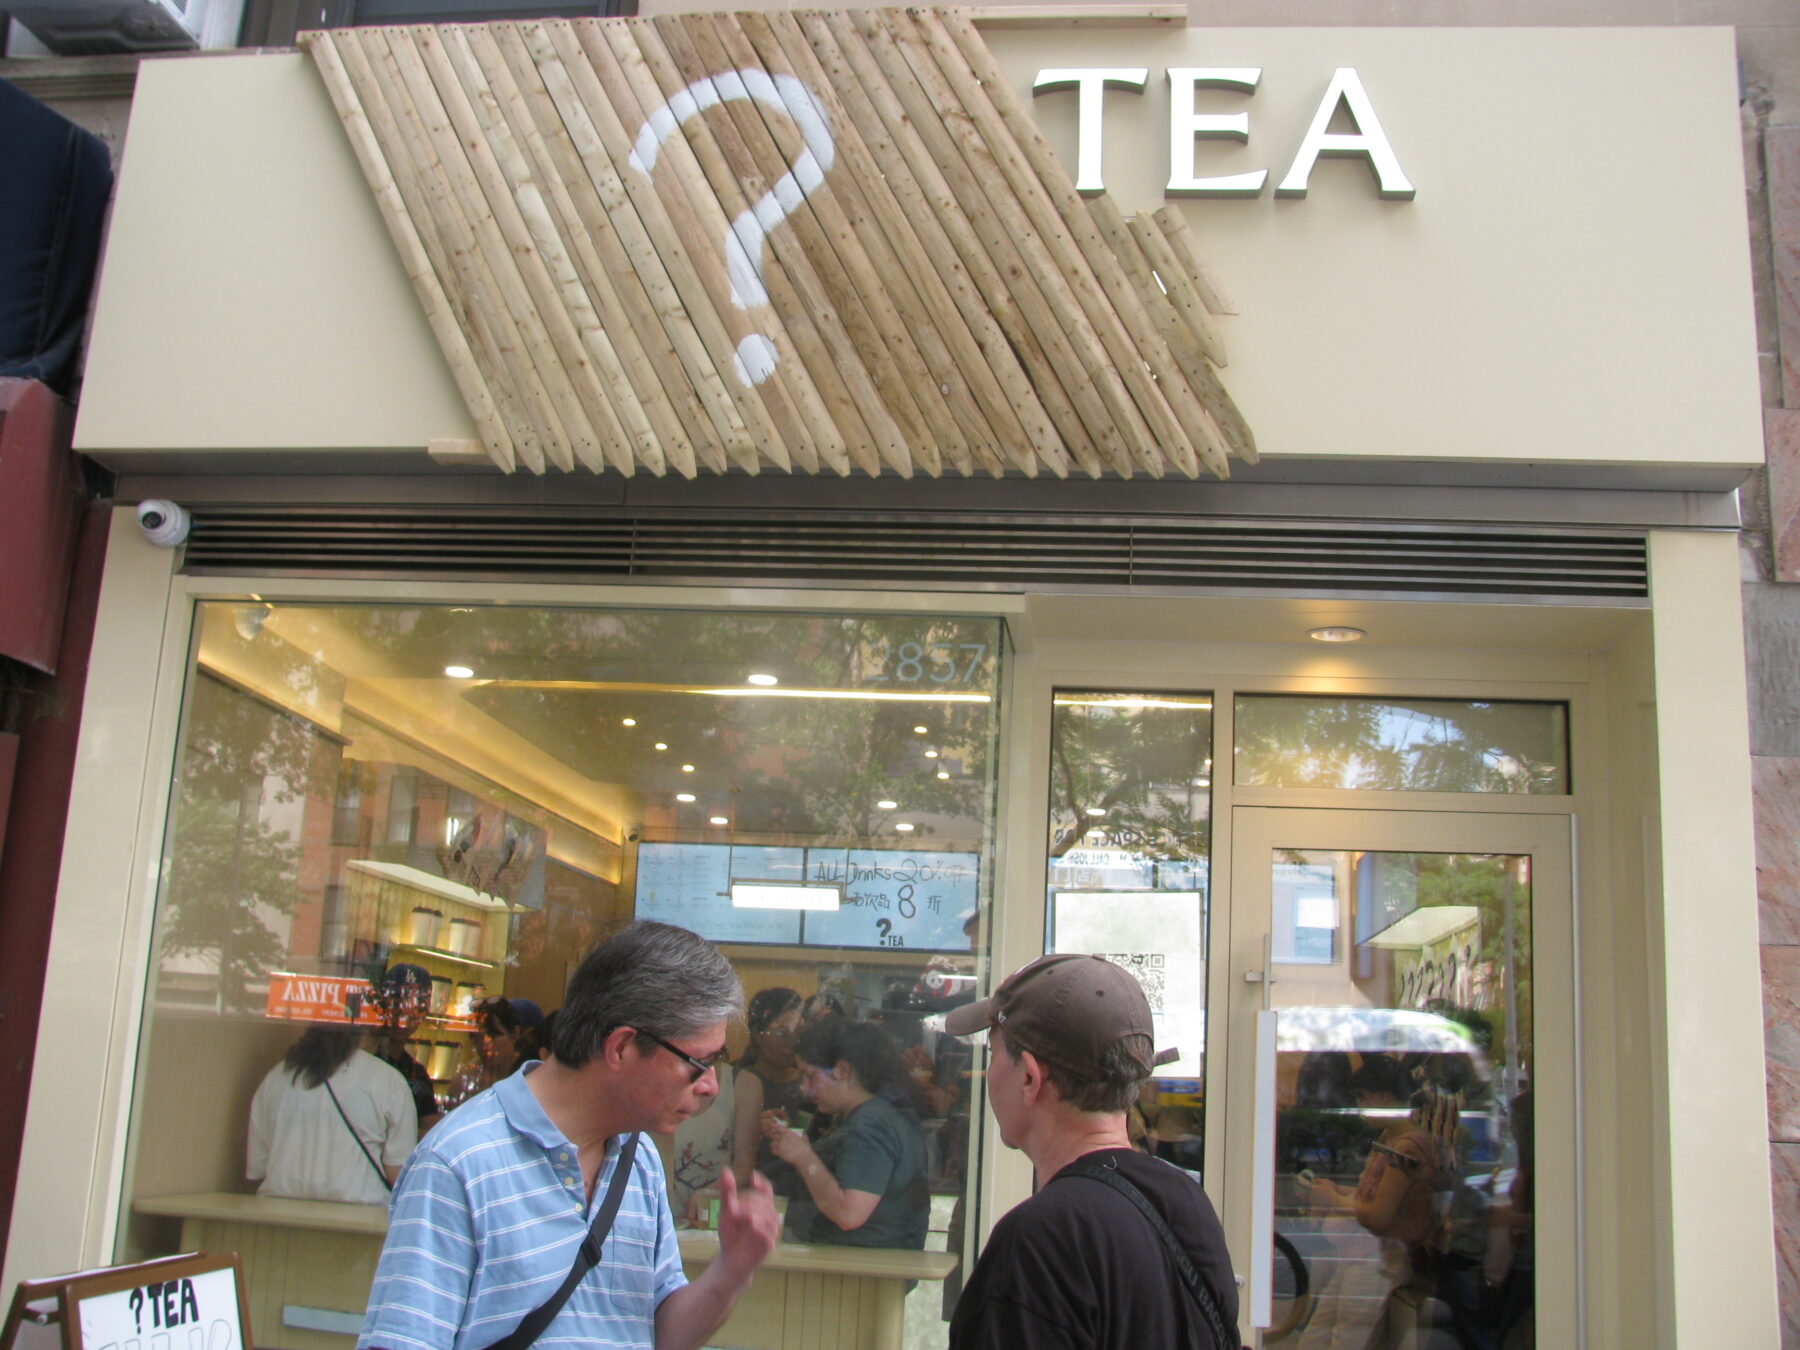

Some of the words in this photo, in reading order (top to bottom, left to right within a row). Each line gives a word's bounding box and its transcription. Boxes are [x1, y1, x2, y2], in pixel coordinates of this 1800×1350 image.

[1032, 66, 1417, 202] TEA
[864, 642, 987, 683] 2857
[814, 859, 844, 883] ALL
[893, 858, 944, 885] 20%
[897, 884, 916, 919] 8
[888, 935, 904, 947] TEA
